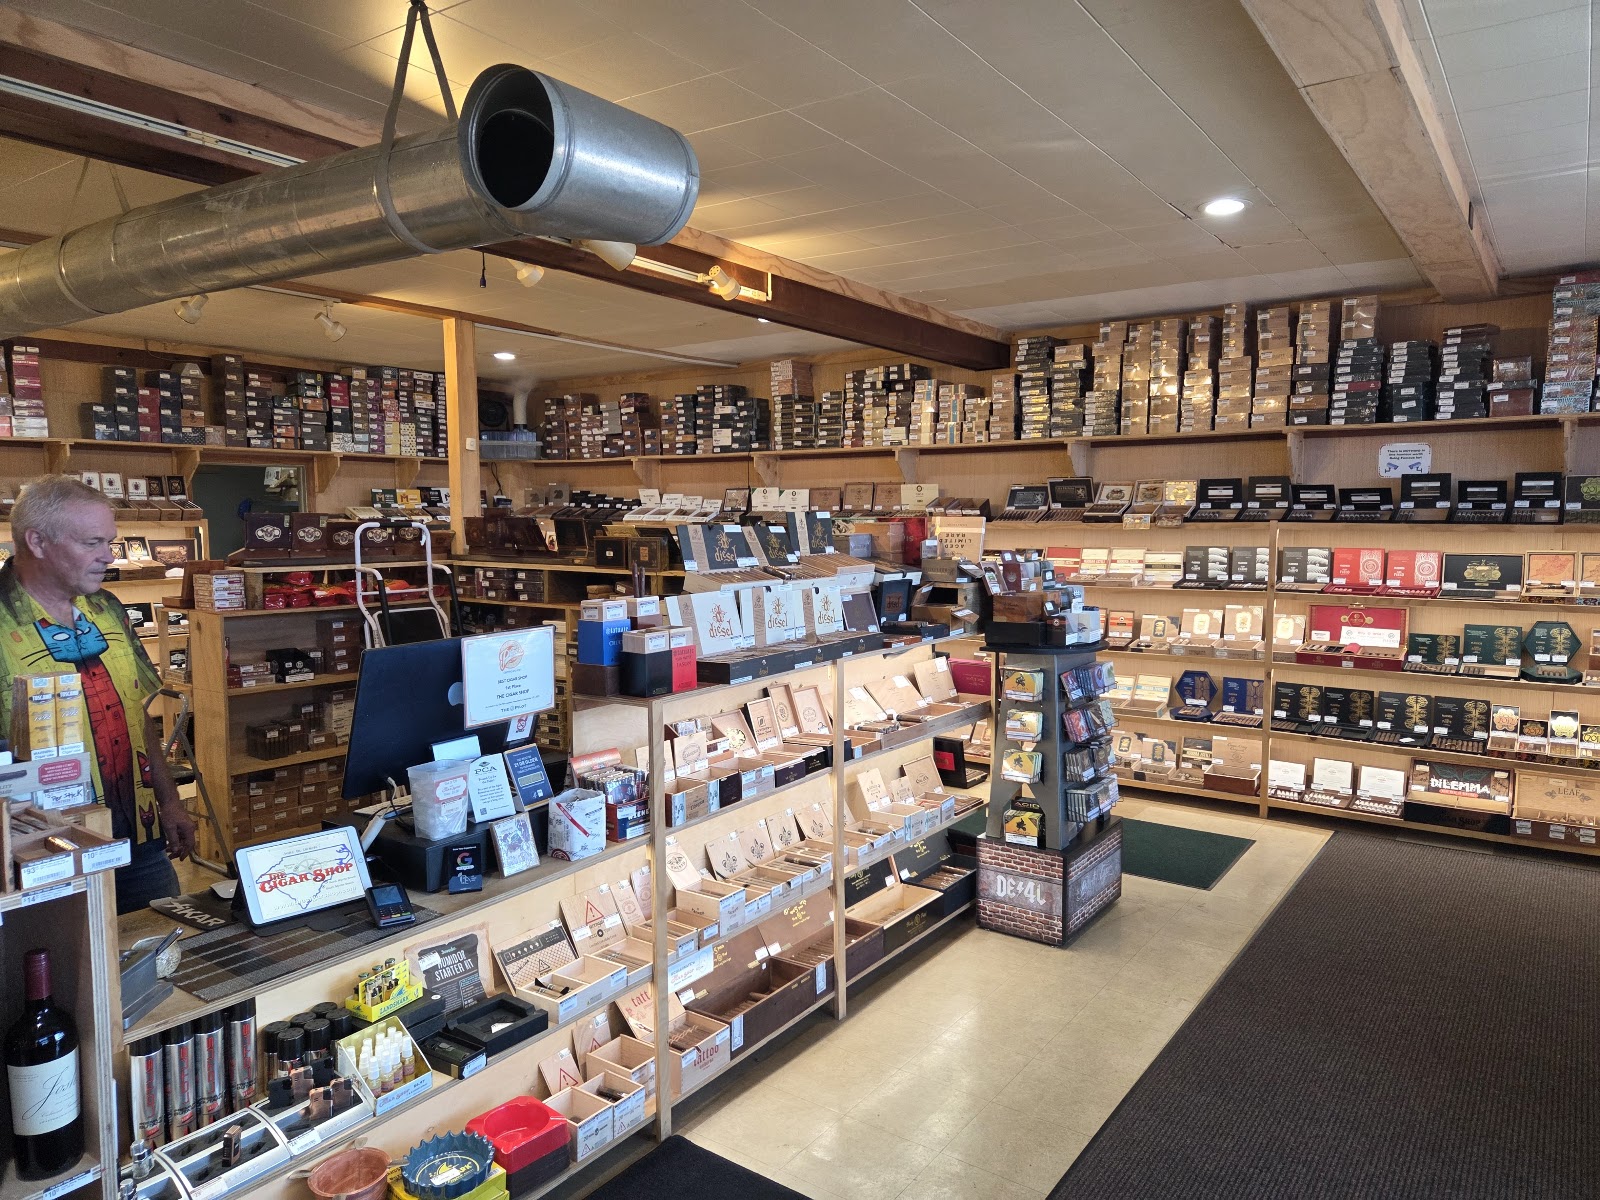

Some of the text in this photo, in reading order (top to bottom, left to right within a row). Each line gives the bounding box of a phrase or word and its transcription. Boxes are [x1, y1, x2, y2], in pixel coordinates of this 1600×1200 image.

[767, 611, 788, 629] diesel
[818, 609, 836, 625] diesel
[708, 618, 733, 638] diesel
[474, 766, 497, 775] PCA
[1430, 777, 1490, 794] DILEMMA
[1558, 787, 1581, 796] LEAF
[259, 863, 353, 893] CIGAR SHOP
[268, 871, 287, 881] THE
[162, 901, 226, 927] XIKAR
[437, 950, 467, 969] HUMIDOR
[434, 962, 465, 981] STARTER
[380, 996, 409, 1014] LANDSHARK
[693, 1045, 719, 1067] tattoo
[180, 1046, 190, 1105] LOTUS
[145, 1057, 155, 1118] LOTUS
